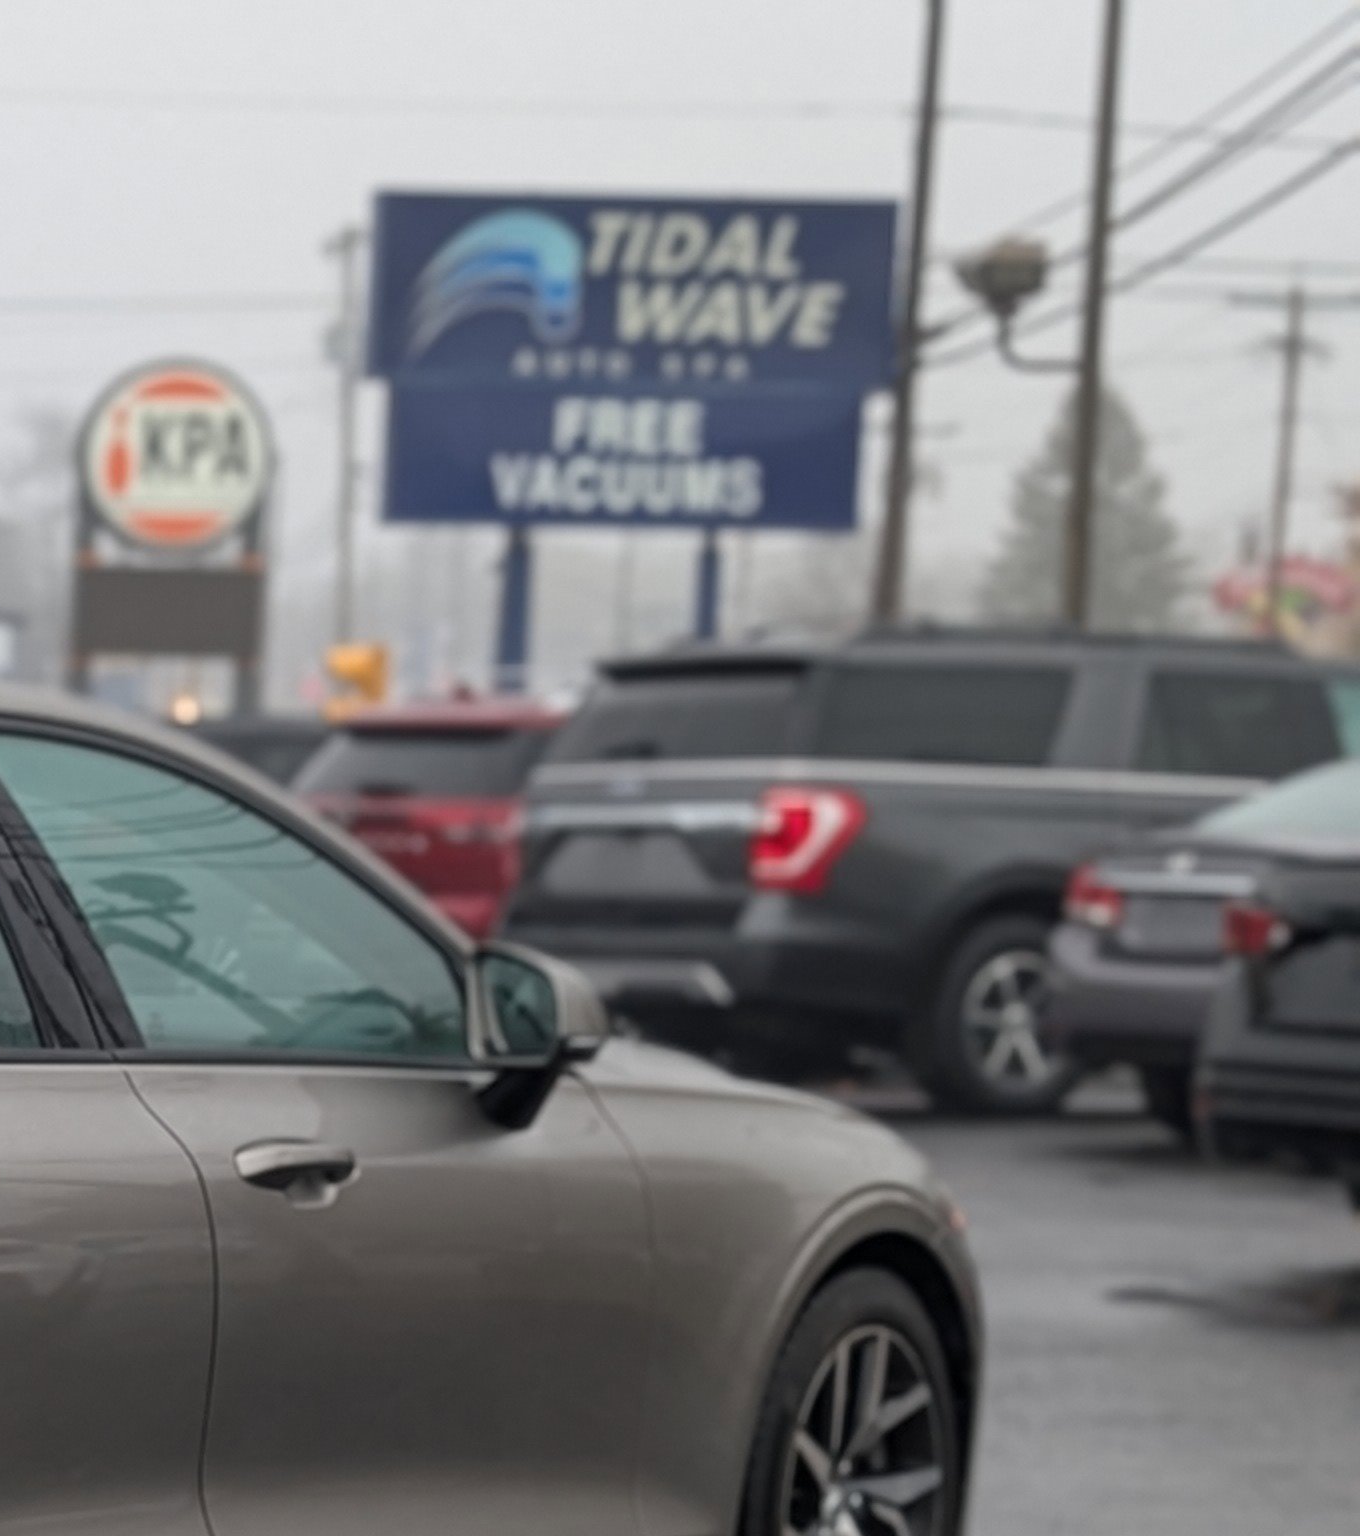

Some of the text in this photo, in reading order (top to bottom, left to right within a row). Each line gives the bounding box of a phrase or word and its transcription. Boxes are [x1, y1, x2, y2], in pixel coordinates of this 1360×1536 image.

[589, 211, 800, 277] TIDAL
[616, 283, 844, 346] WAVE
[140, 411, 250, 479] KPA
[554, 401, 705, 455] FREE
[490, 457, 764, 514] VACUUMS
